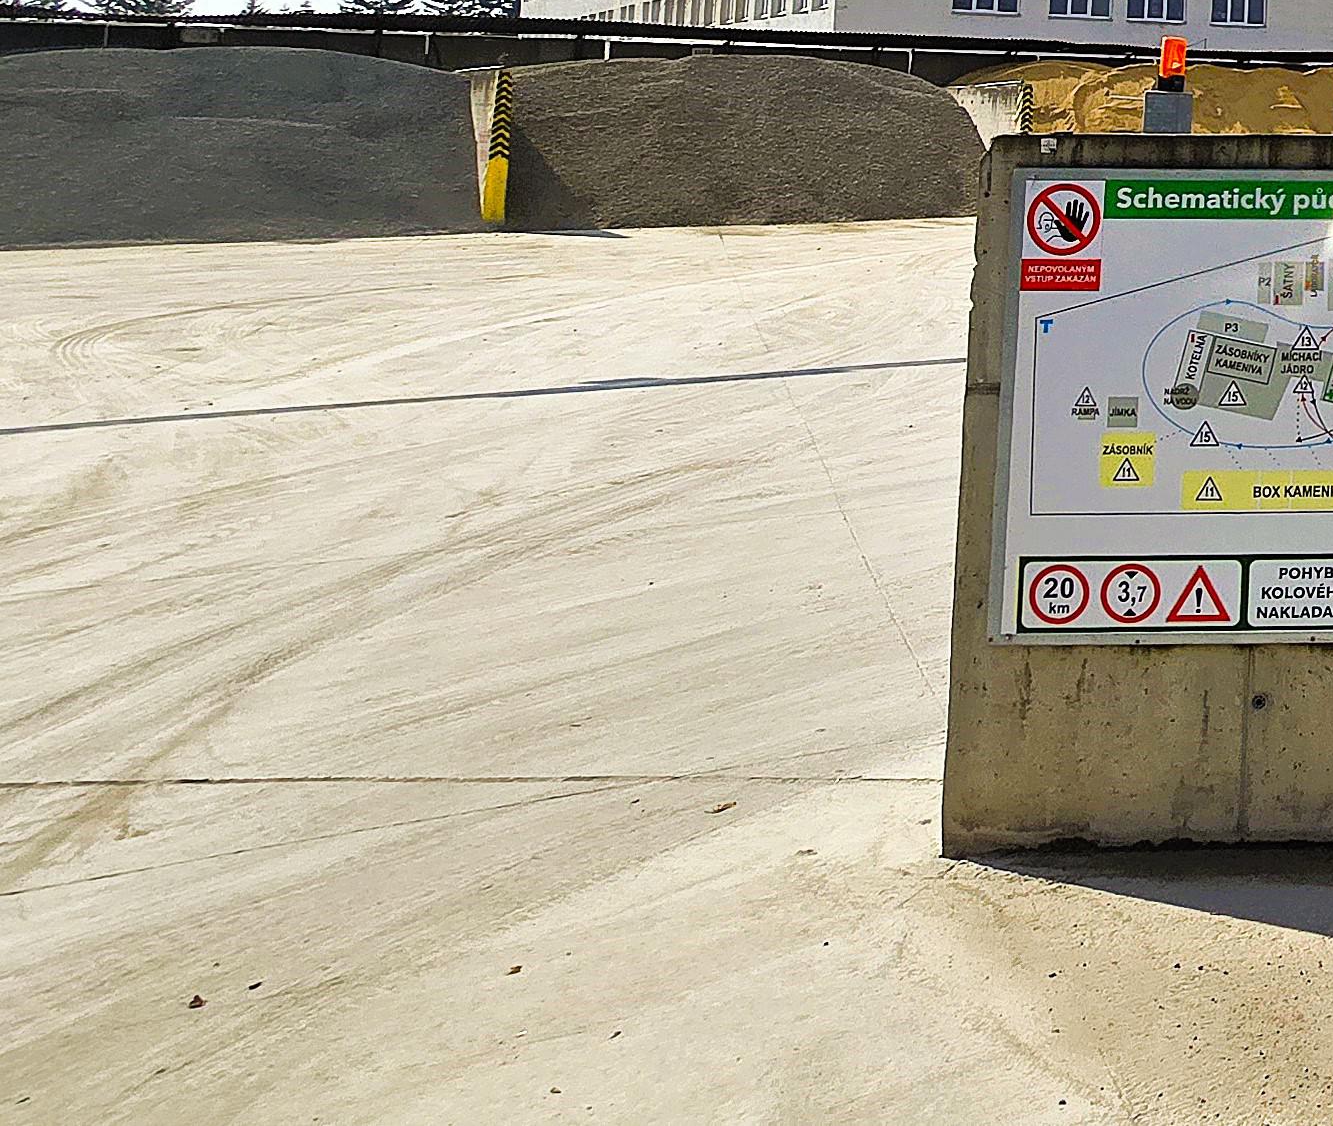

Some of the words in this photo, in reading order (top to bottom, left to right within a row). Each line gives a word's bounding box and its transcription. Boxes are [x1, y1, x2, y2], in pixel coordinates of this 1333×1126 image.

[1117, 187, 1285, 215] Schematický
[1259, 277, 1271, 286] P2
[1281, 264, 1294, 298] ŠATNY
[1224, 323, 1239, 333] P3
[1185, 334, 1208, 380] KOTELNA
[1215, 344, 1270, 364] ZÁSOBNÍKY
[1215, 358, 1263, 375] KAMENIVA
[1280, 362, 1314, 374] JÁDRO
[1071, 408, 1100, 416] RAMPA
[1109, 407, 1137, 417] JÍMKA
[1102, 442, 1154, 455] ZÁSOBNÍK
[1253, 486, 1280, 498] BOX
[1278, 567, 1333, 580] POHYB
[1043, 577, 1074, 599] 20
[1117, 581, 1147, 606] 3,7
[1049, 602, 1070, 615] km
